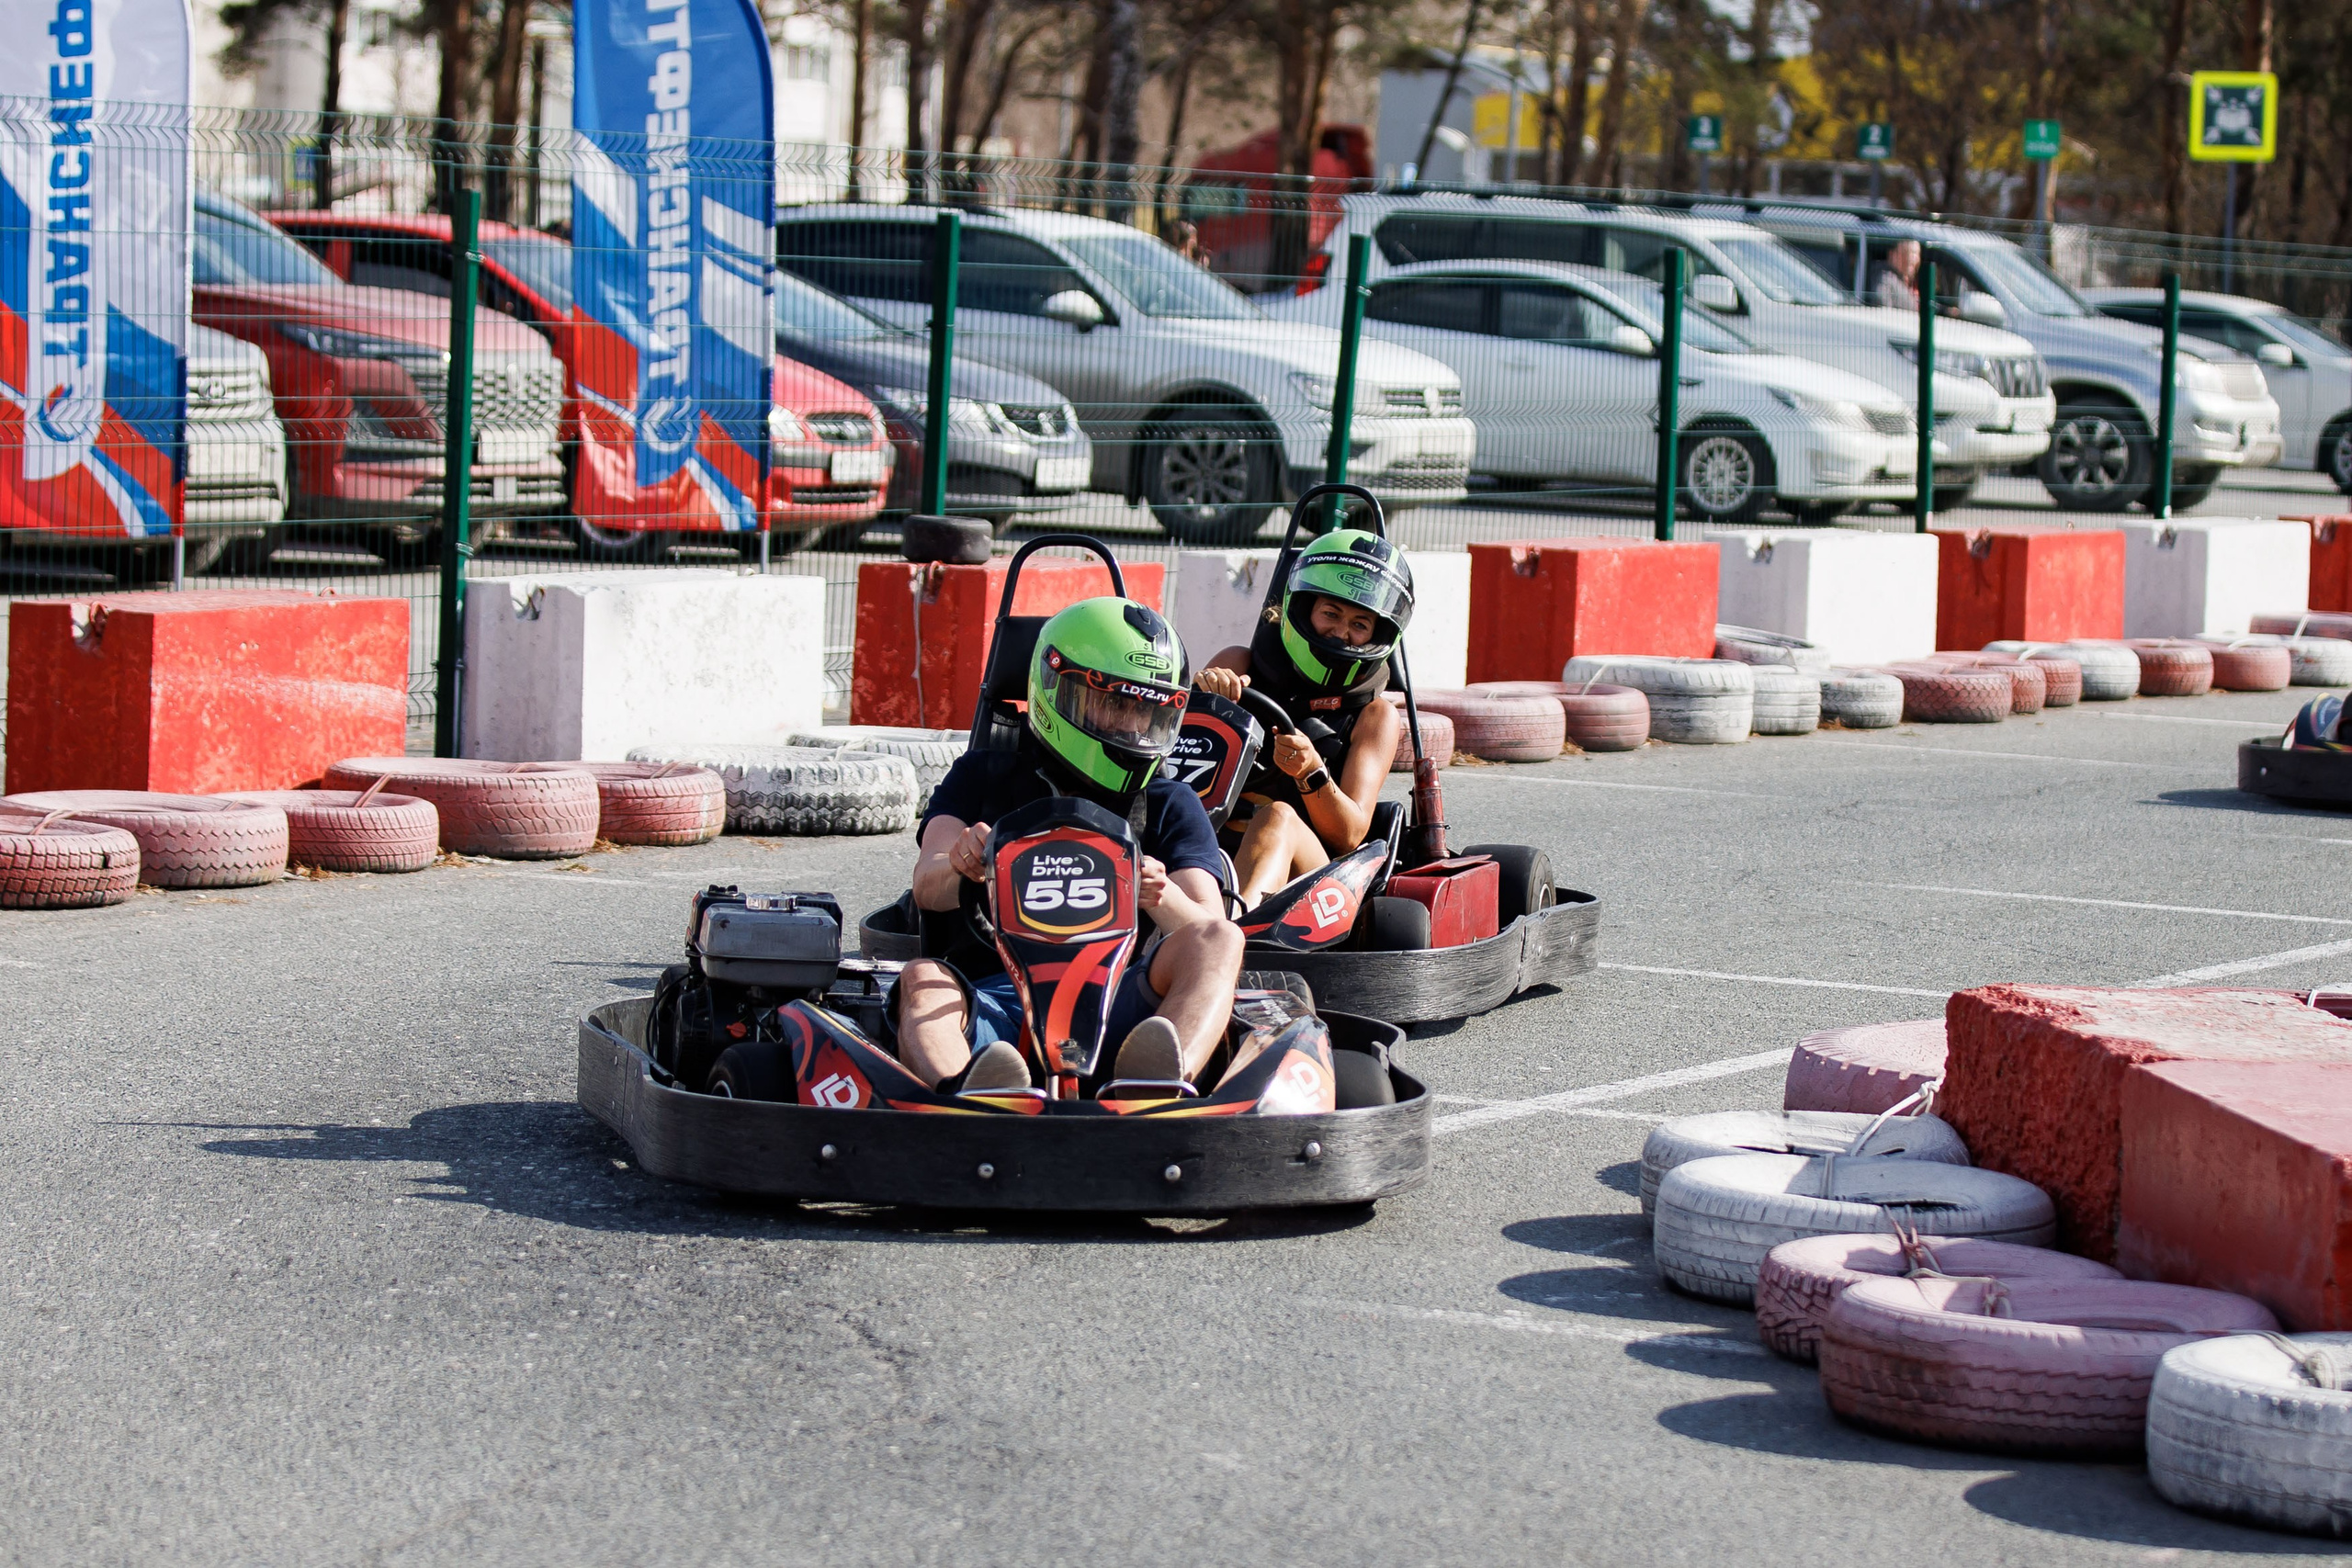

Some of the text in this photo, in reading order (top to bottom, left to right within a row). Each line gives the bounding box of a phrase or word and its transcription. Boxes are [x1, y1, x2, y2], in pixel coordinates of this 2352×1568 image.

[1338, 557, 1380, 572] жажду
[1342, 573, 1374, 592] GSB
[1132, 654, 1168, 671] GSB
[1121, 683, 1170, 702] LD72.ru
[1175, 736, 1198, 745] ive
[1172, 745, 1202, 754] rive
[1033, 855, 1074, 865] Live
[1032, 865, 1084, 876] Drive
[1023, 878, 1108, 910] 55
[1312, 887, 1345, 929] LD
